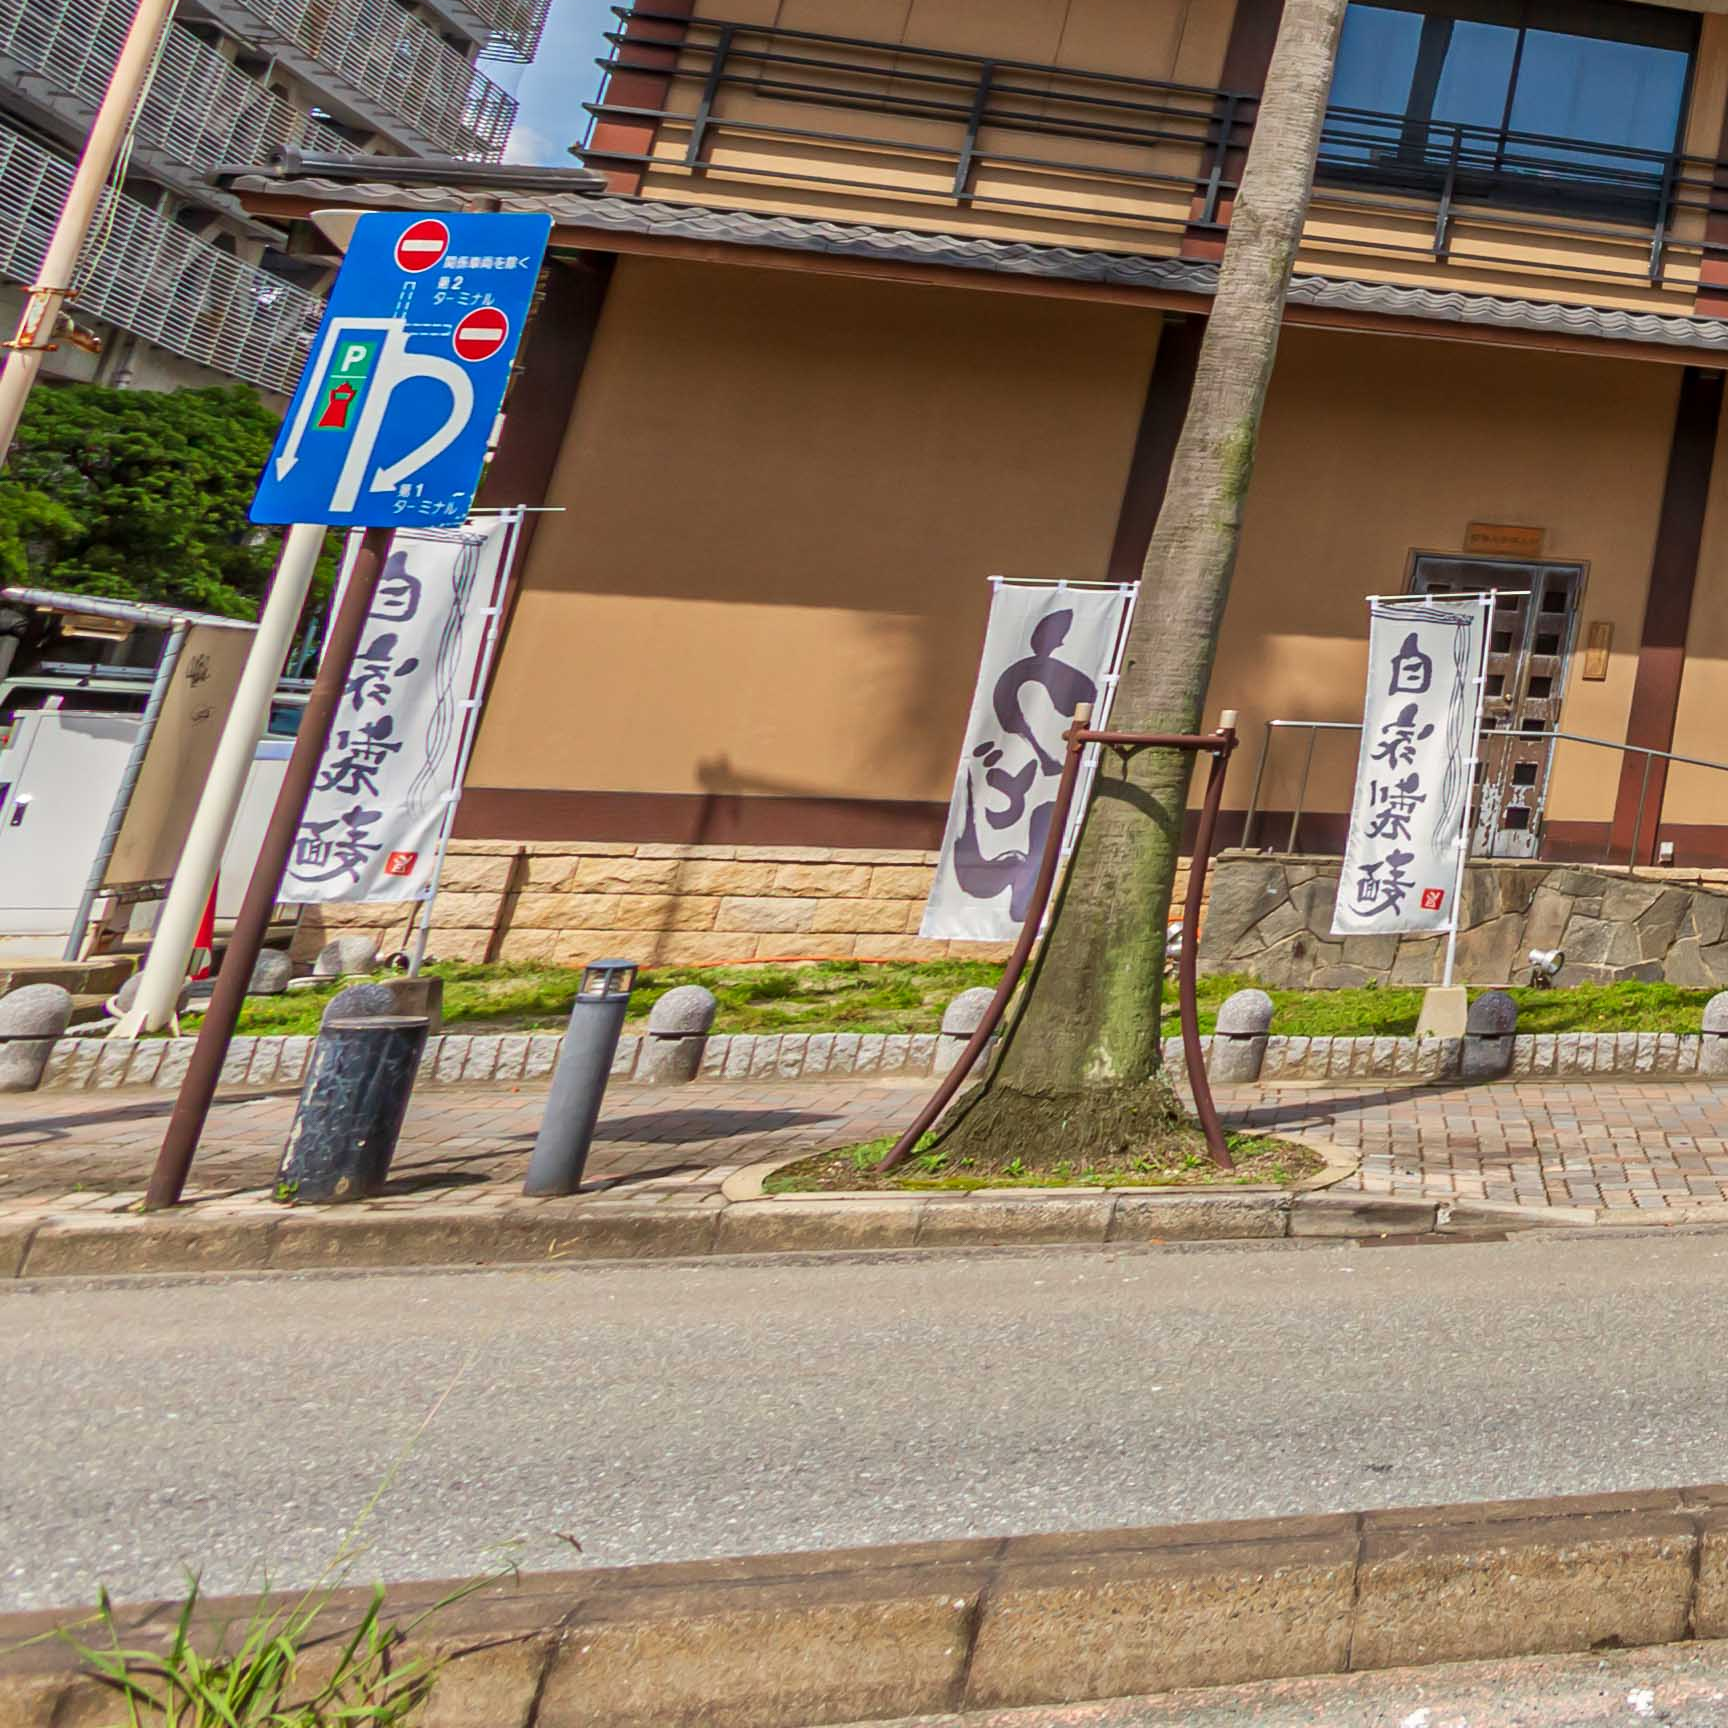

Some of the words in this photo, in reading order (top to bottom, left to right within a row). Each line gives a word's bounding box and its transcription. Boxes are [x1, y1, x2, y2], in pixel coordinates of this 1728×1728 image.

[433, 291, 495, 306] ターミナル
[340, 345, 367, 372] P
[392, 499, 458, 515] ターミナル
